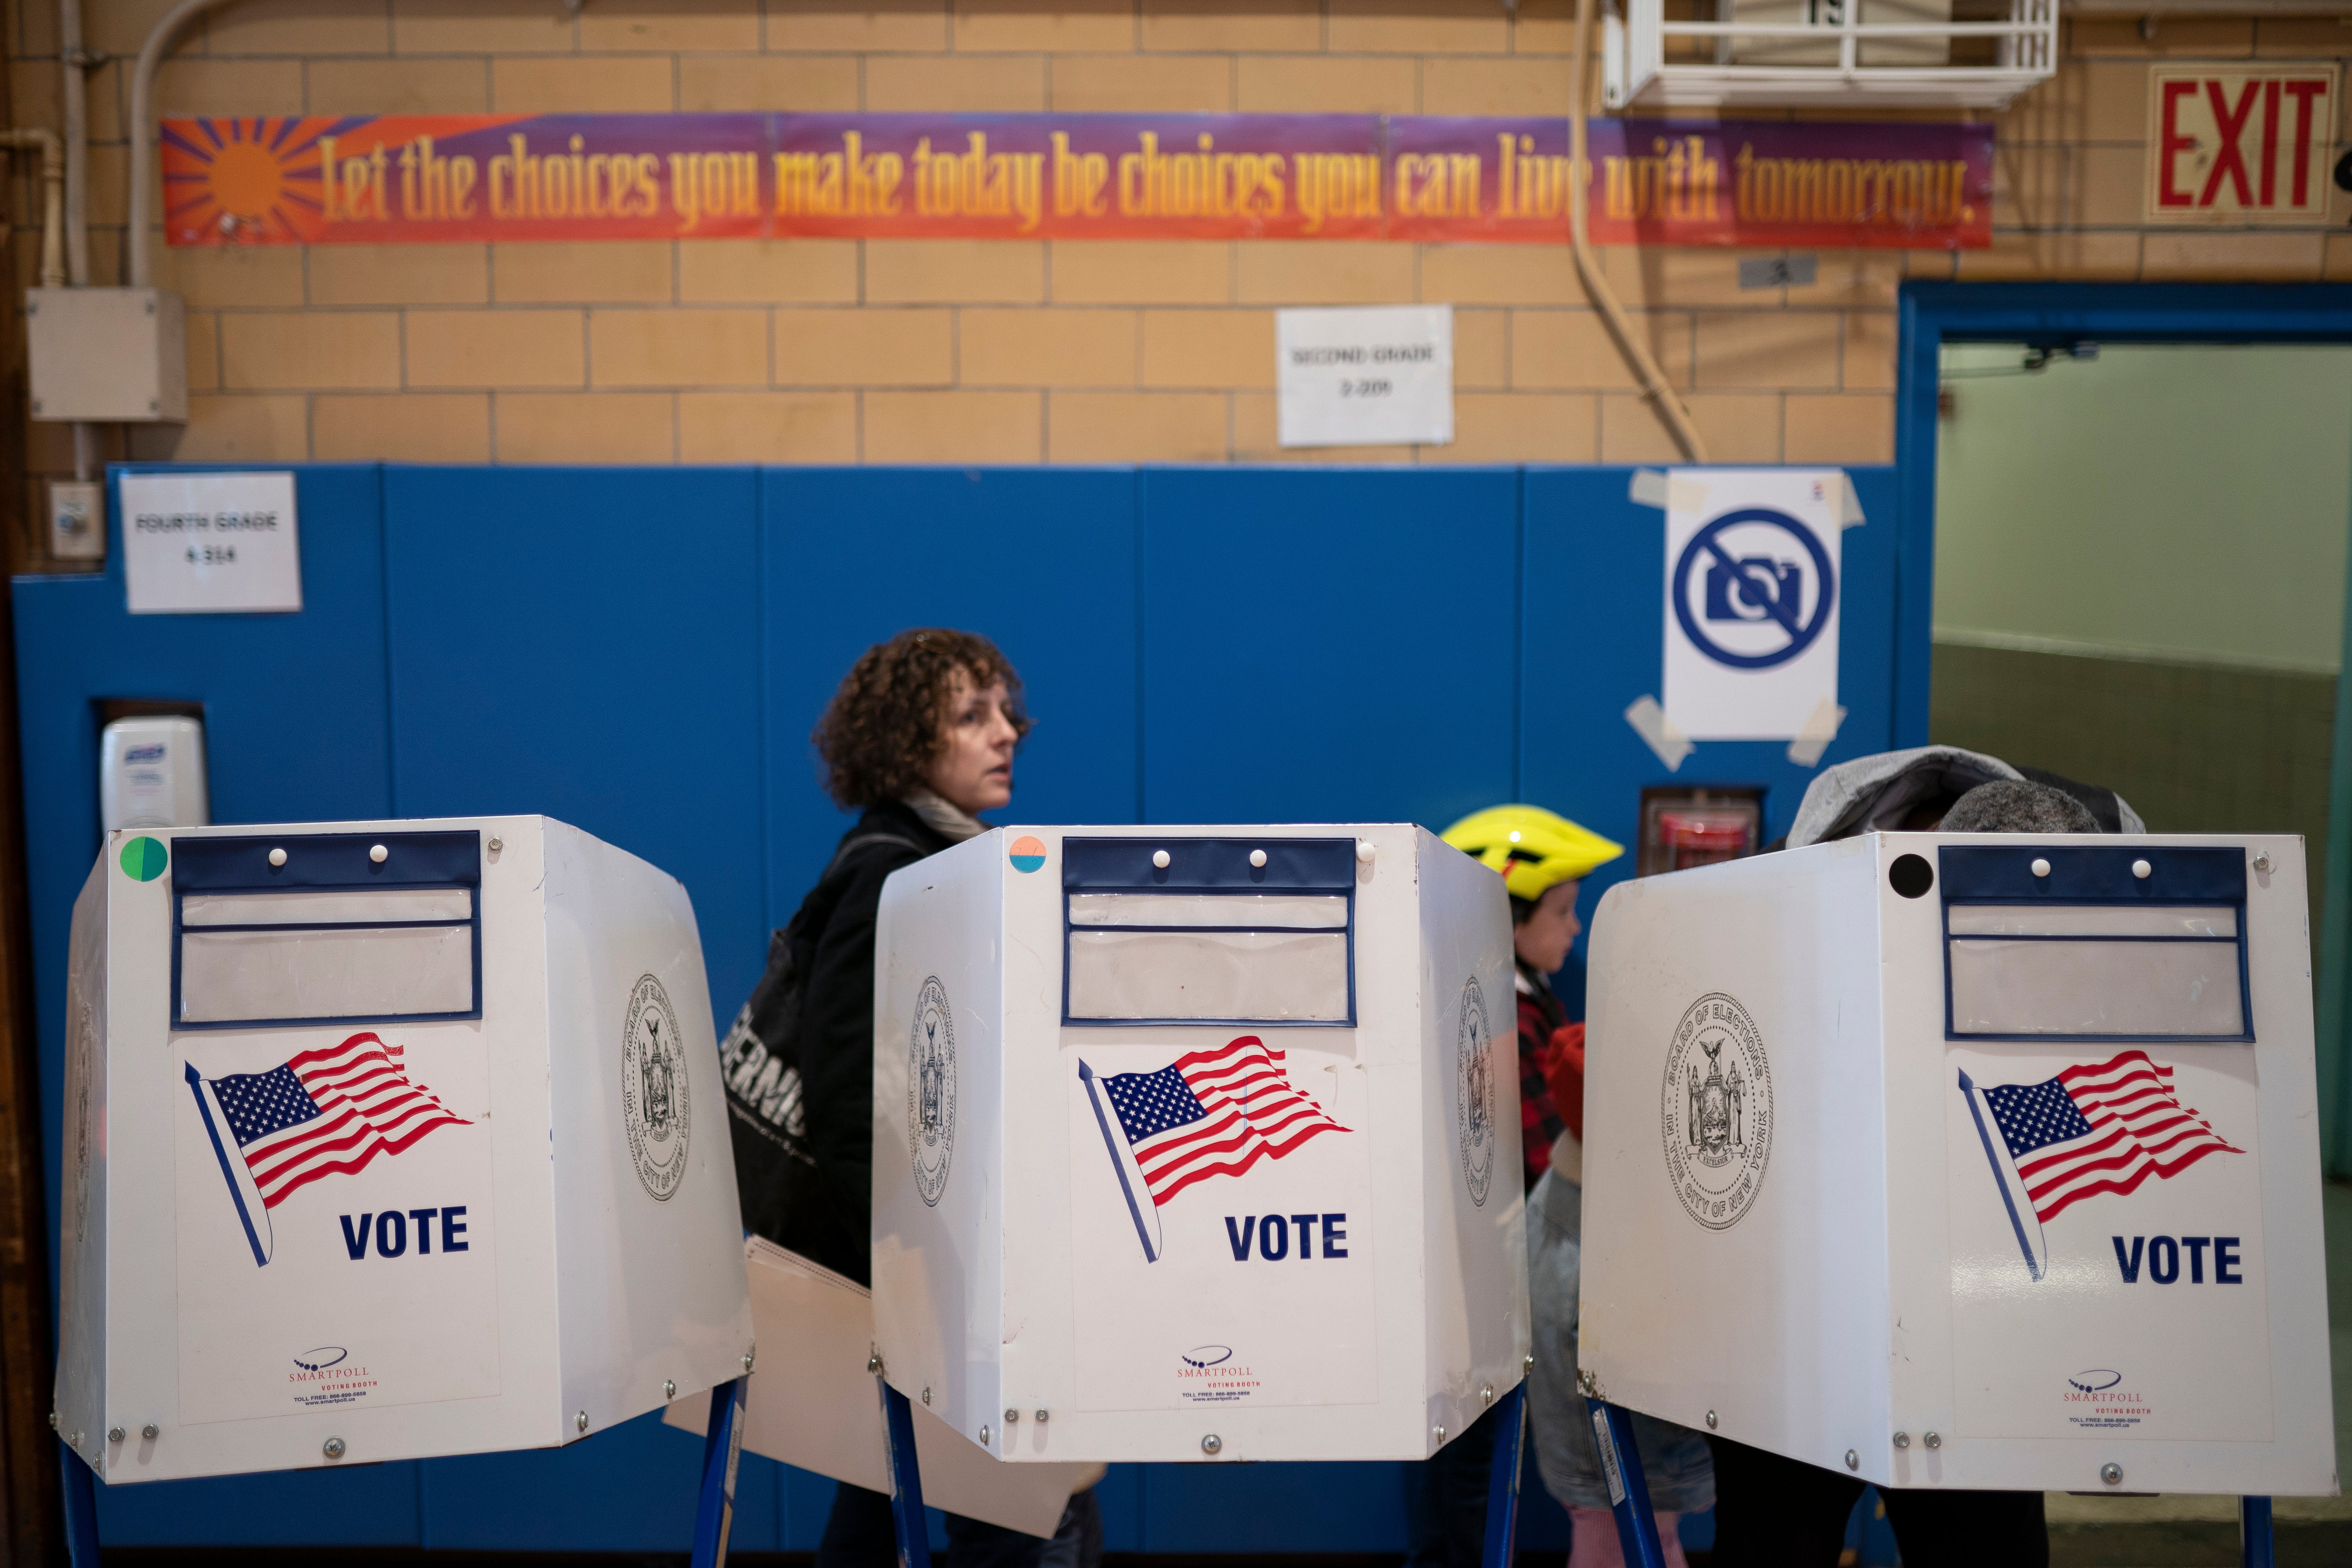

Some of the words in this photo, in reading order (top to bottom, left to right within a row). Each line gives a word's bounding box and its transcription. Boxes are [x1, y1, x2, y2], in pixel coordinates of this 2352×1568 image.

[2160, 81, 2327, 206] EXIT
[318, 134, 389, 222] Let
[398, 133, 478, 220] the
[488, 132, 660, 219] choices
[667, 151, 759, 233] you
[771, 129, 904, 217] make
[911, 130, 1045, 233] today
[1049, 130, 1109, 217] be
[1118, 130, 1286, 218] choices
[1293, 152, 1381, 234] you
[1395, 152, 1481, 218] can
[1602, 134, 1719, 221] with
[1736, 141, 1975, 224] tomorrow.
[135, 513, 209, 533] FOURTH
[214, 510, 278, 532] GRADE
[626, 997, 641, 1062] BOARD
[1668, 1021, 1693, 1086] BOARD
[1695, 1005, 1709, 1025] OF
[1713, 1003, 1763, 1080] ELECTIONS
[643, 1160, 660, 1189] CITY
[1666, 1114, 1674, 1136] IN
[1670, 1140, 1685, 1183] THE
[1685, 1183, 1710, 1214] CITY
[1711, 1200, 1726, 1217] OF
[1728, 1172, 1752, 1212] NEW
[1750, 1110, 1767, 1171] YORK
[1703, 1156, 1728, 1166] EXCELSIOR
[339, 1206, 468, 1260] VOTE
[1224, 1213, 1348, 1262] VOTE
[2111, 1235, 2242, 1284] VOTE
[289, 1367, 369, 1382] SMARTPOLL
[1178, 1368, 1252, 1378] SMARTPOLL
[2064, 1393, 2142, 1402] SMARTPOLL
